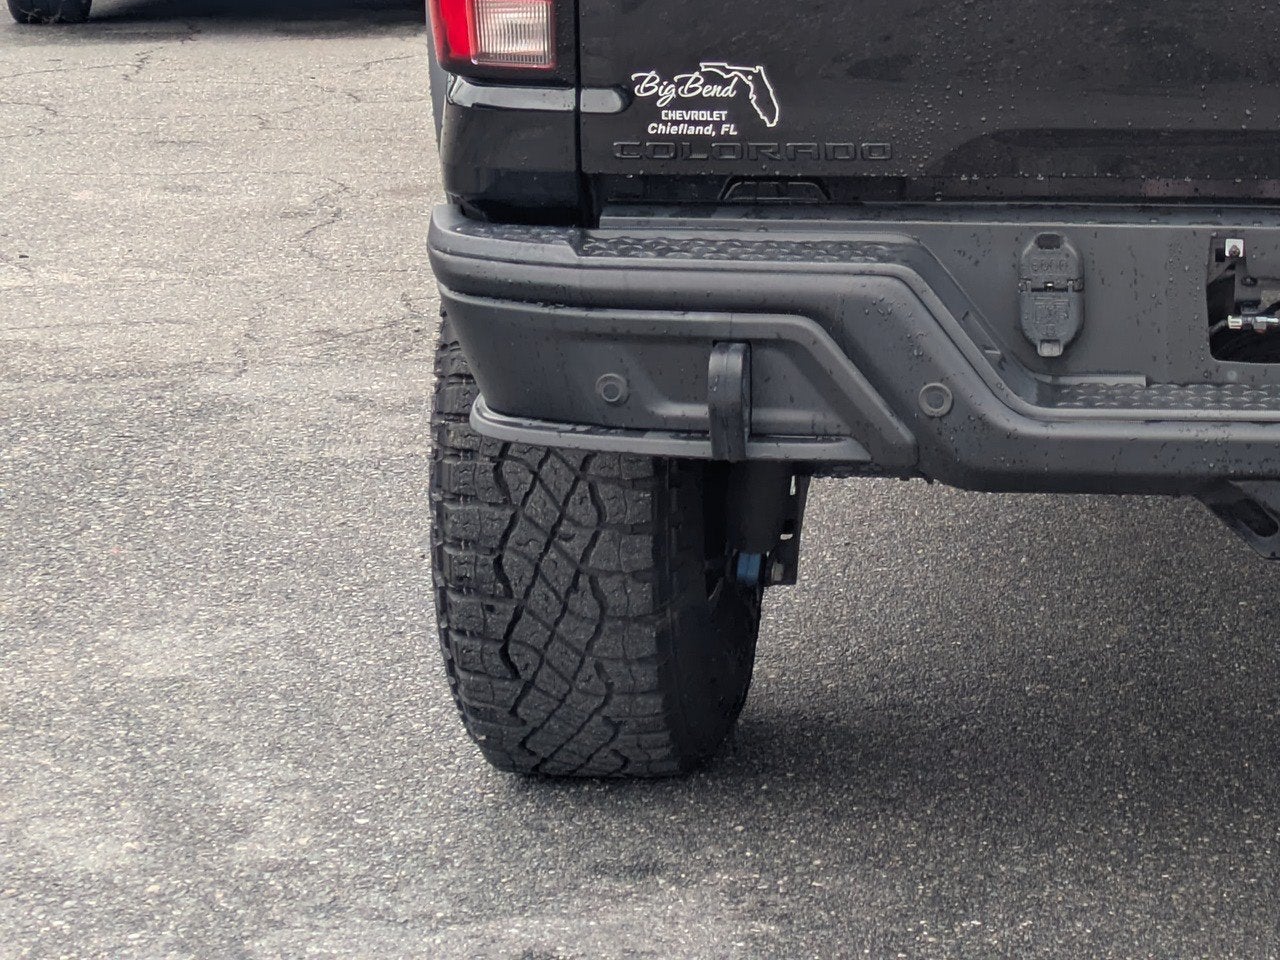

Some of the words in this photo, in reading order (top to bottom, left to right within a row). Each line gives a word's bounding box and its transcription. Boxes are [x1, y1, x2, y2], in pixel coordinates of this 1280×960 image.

[631, 70, 677, 107] Big
[674, 71, 739, 98] Bend
[661, 109, 728, 121] CHEVROLET
[647, 123, 716, 137] Chiefland,
[720, 123, 738, 135] FL
[612, 141, 894, 161] COLORADO
